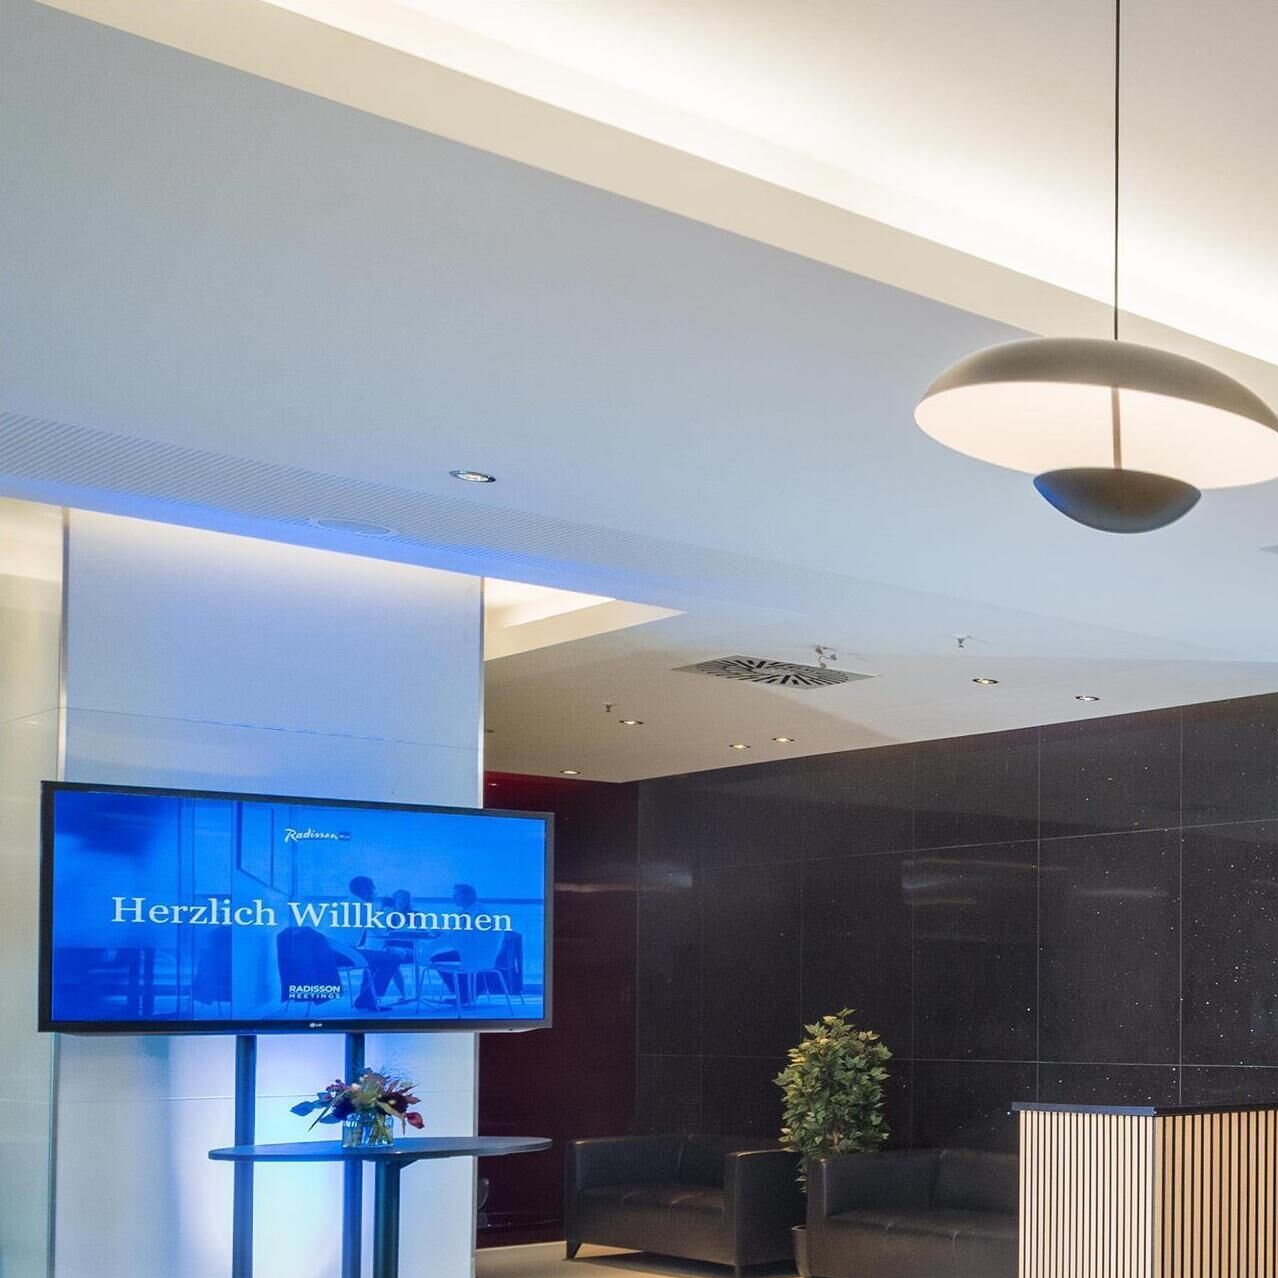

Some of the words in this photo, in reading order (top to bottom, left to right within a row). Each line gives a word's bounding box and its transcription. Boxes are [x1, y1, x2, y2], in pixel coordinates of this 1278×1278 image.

[111, 896, 278, 926] Herzlich
[288, 901, 513, 932] Willkommen
[289, 985, 340, 993] RADISSON
